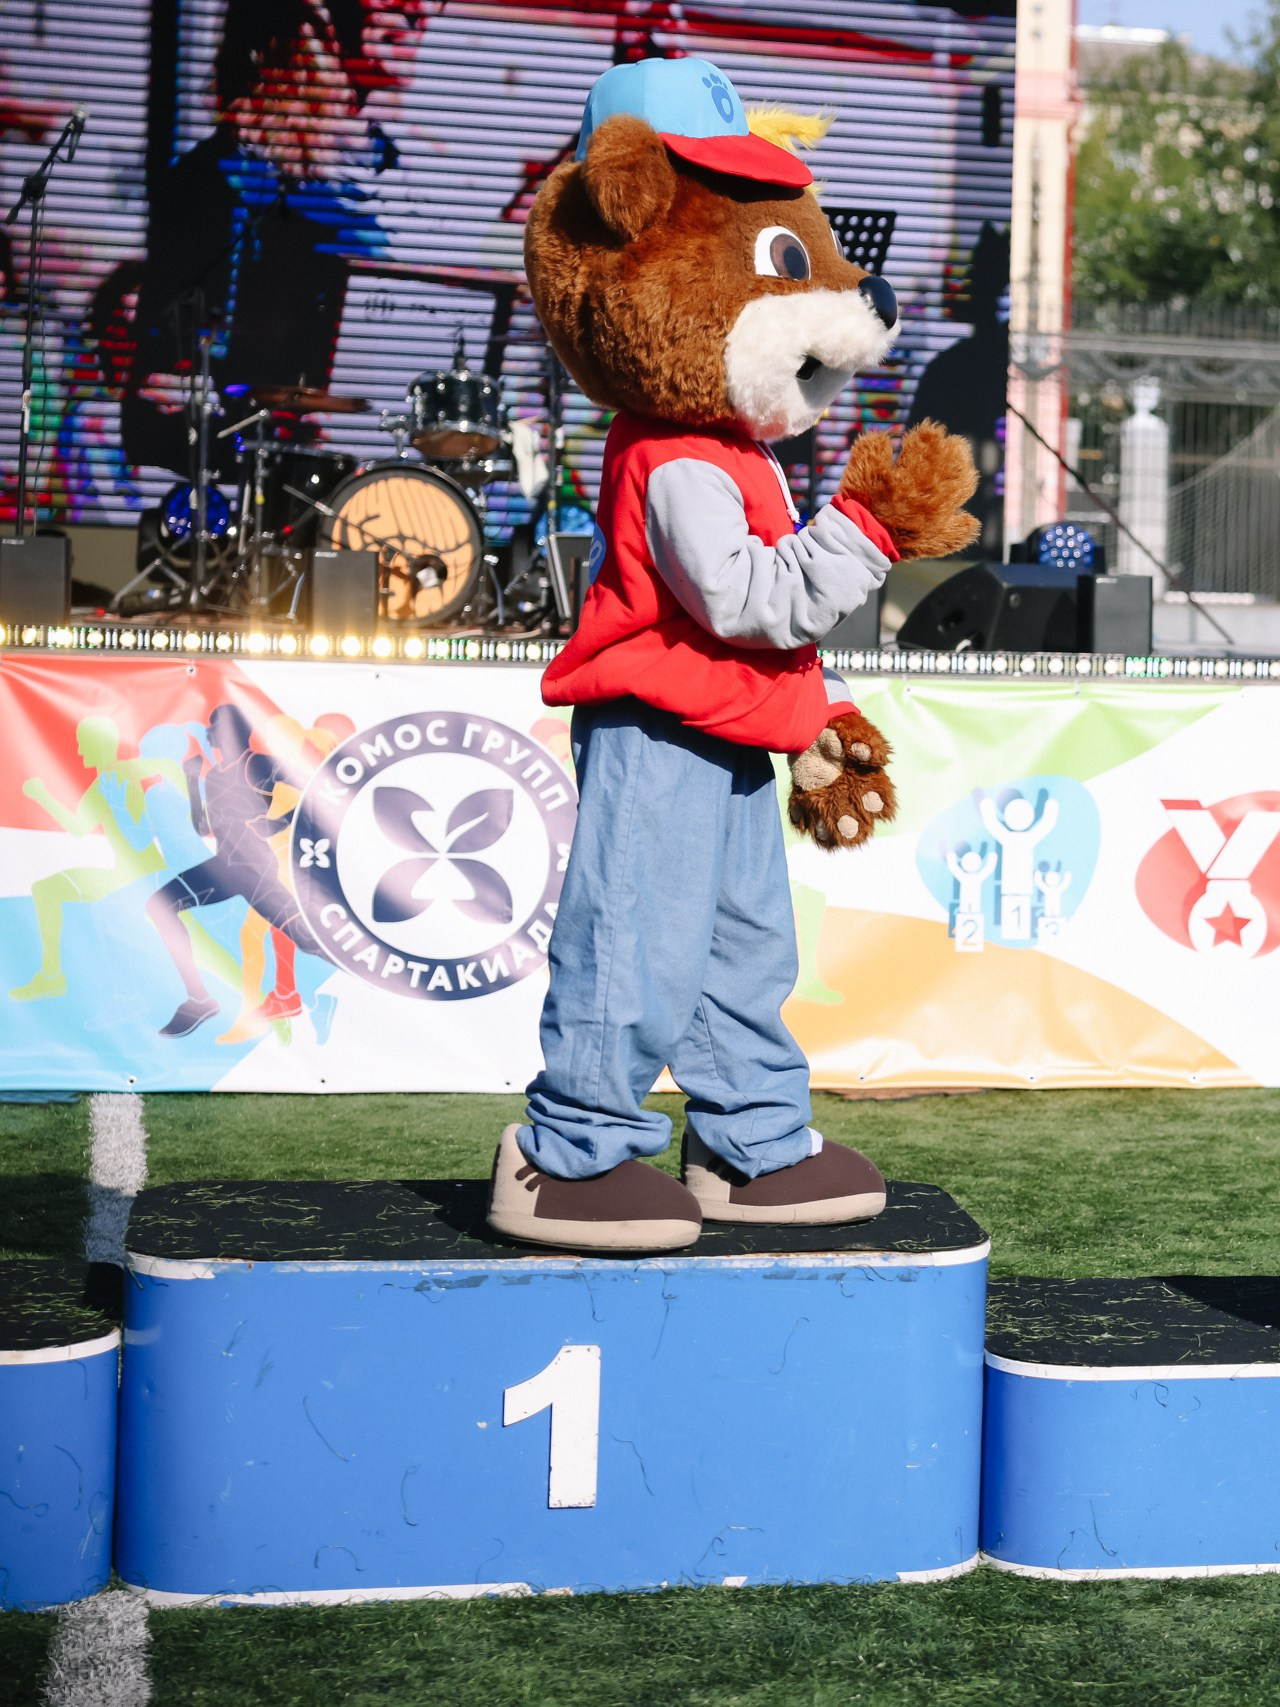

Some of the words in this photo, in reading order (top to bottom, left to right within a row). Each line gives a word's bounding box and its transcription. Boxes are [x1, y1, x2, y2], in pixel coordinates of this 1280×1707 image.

[318, 719, 449, 806] КОМОС
[461, 722, 569, 811] ГРУПП
[961, 919, 979, 946] 2
[502, 1344, 601, 1510] 1
